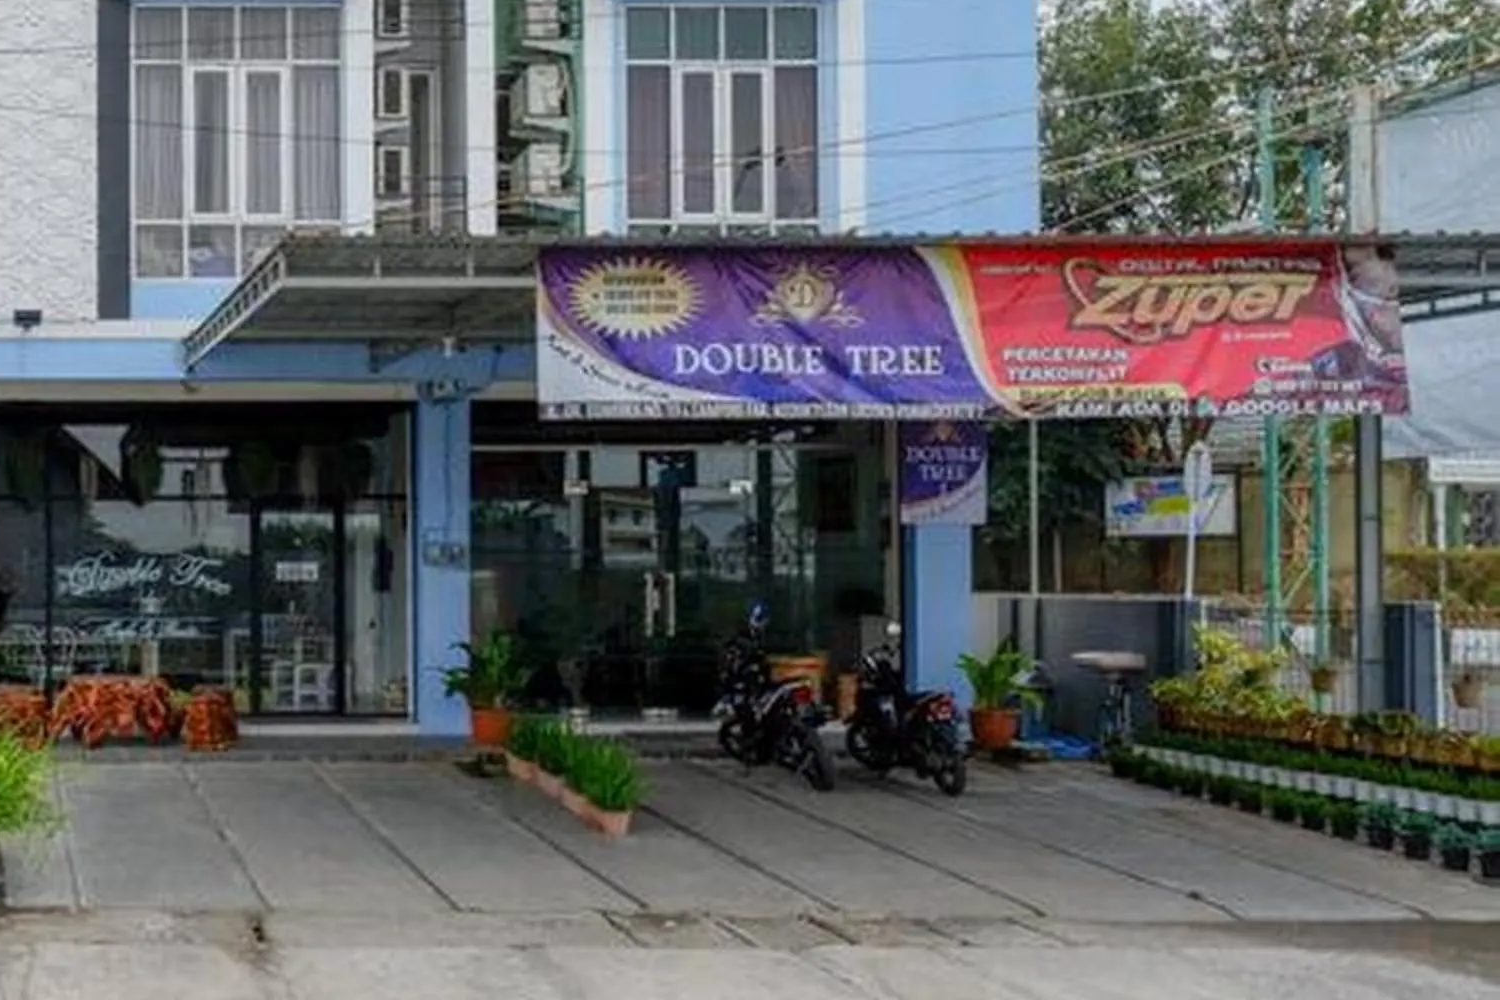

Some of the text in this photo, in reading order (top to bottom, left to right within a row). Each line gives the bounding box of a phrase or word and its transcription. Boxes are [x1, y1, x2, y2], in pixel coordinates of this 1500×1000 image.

[1072, 272, 1319, 336] Zuper
[674, 342, 827, 376] DOUBLE
[845, 344, 945, 376] TREE
[1003, 346, 1128, 363] PERCETAKAN
[1056, 400, 1113, 417] KAMI
[1117, 401, 1163, 418] ADA
[1226, 400, 1317, 415] GOOGLE
[1324, 399, 1383, 415] MAPS
